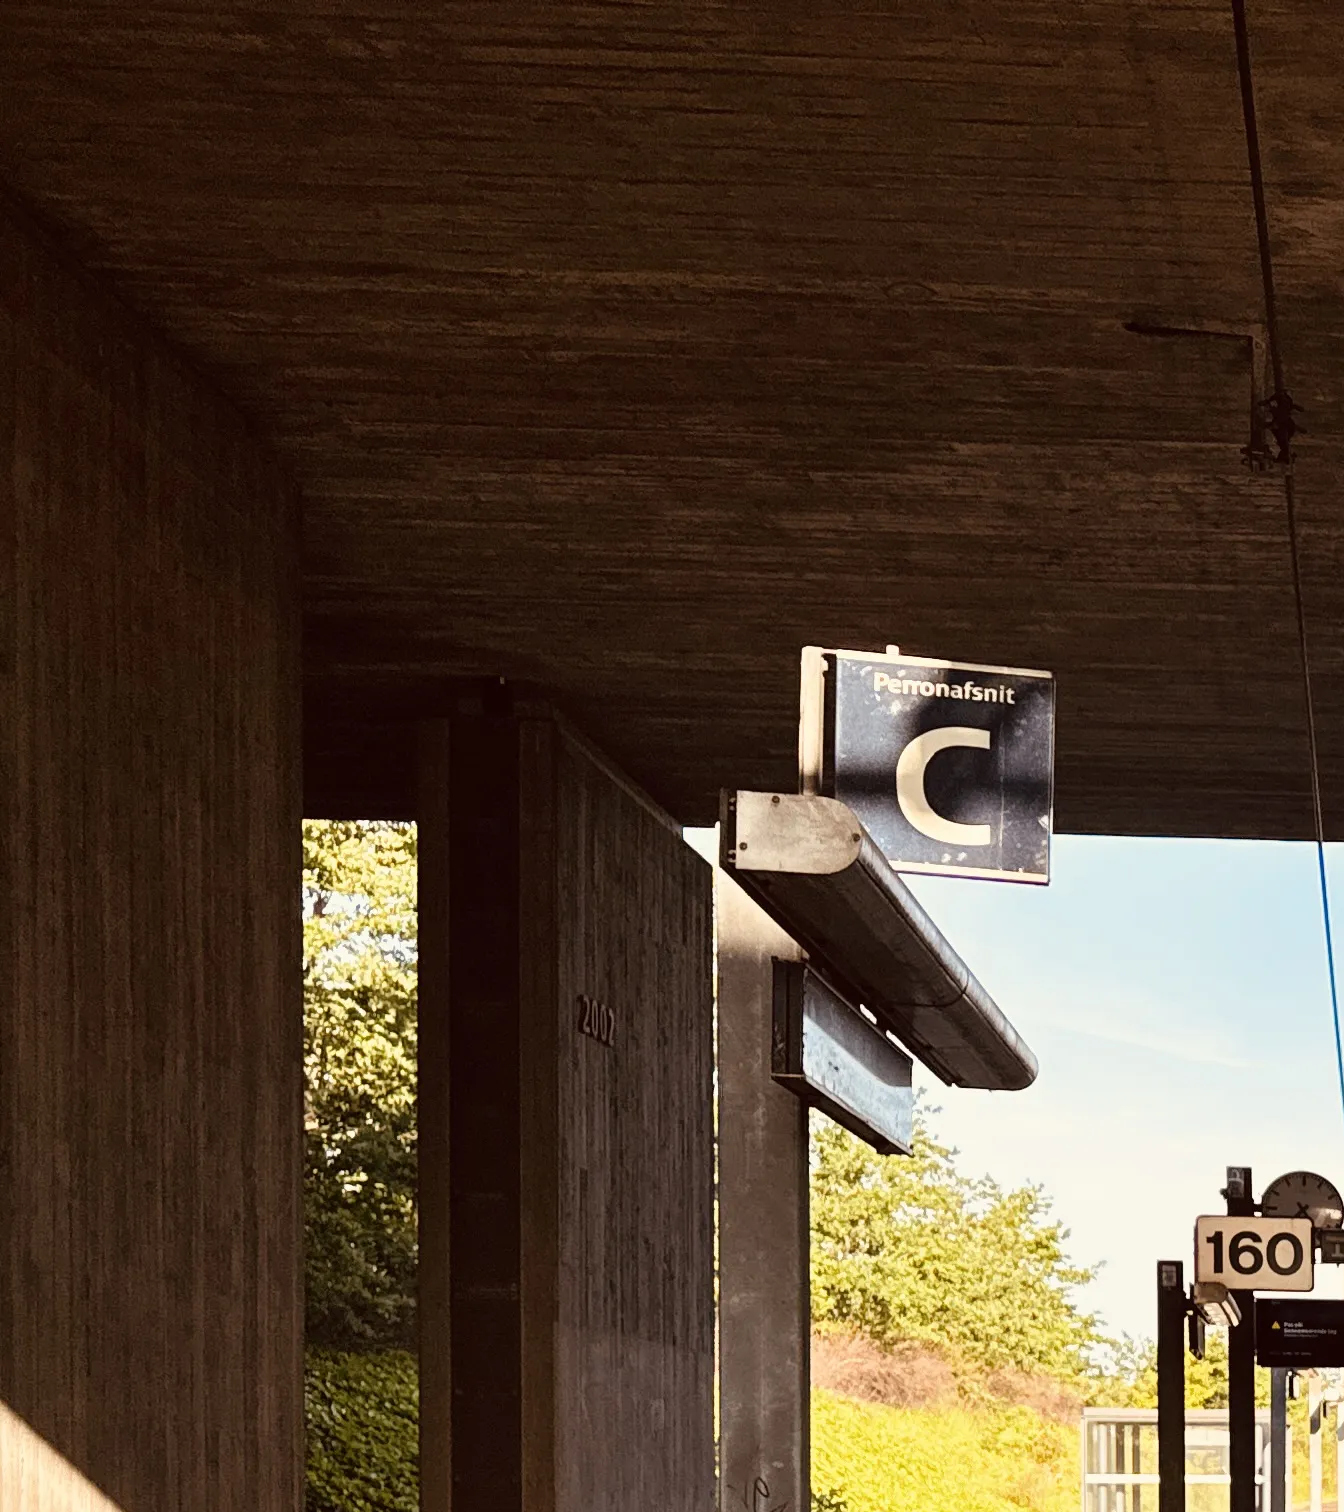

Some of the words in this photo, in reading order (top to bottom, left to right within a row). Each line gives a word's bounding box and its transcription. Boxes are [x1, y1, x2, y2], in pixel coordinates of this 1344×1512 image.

[873, 672, 1015, 705] Perronafsnit
[895, 727, 991, 846] C
[1205, 1230, 1304, 1275] 160
